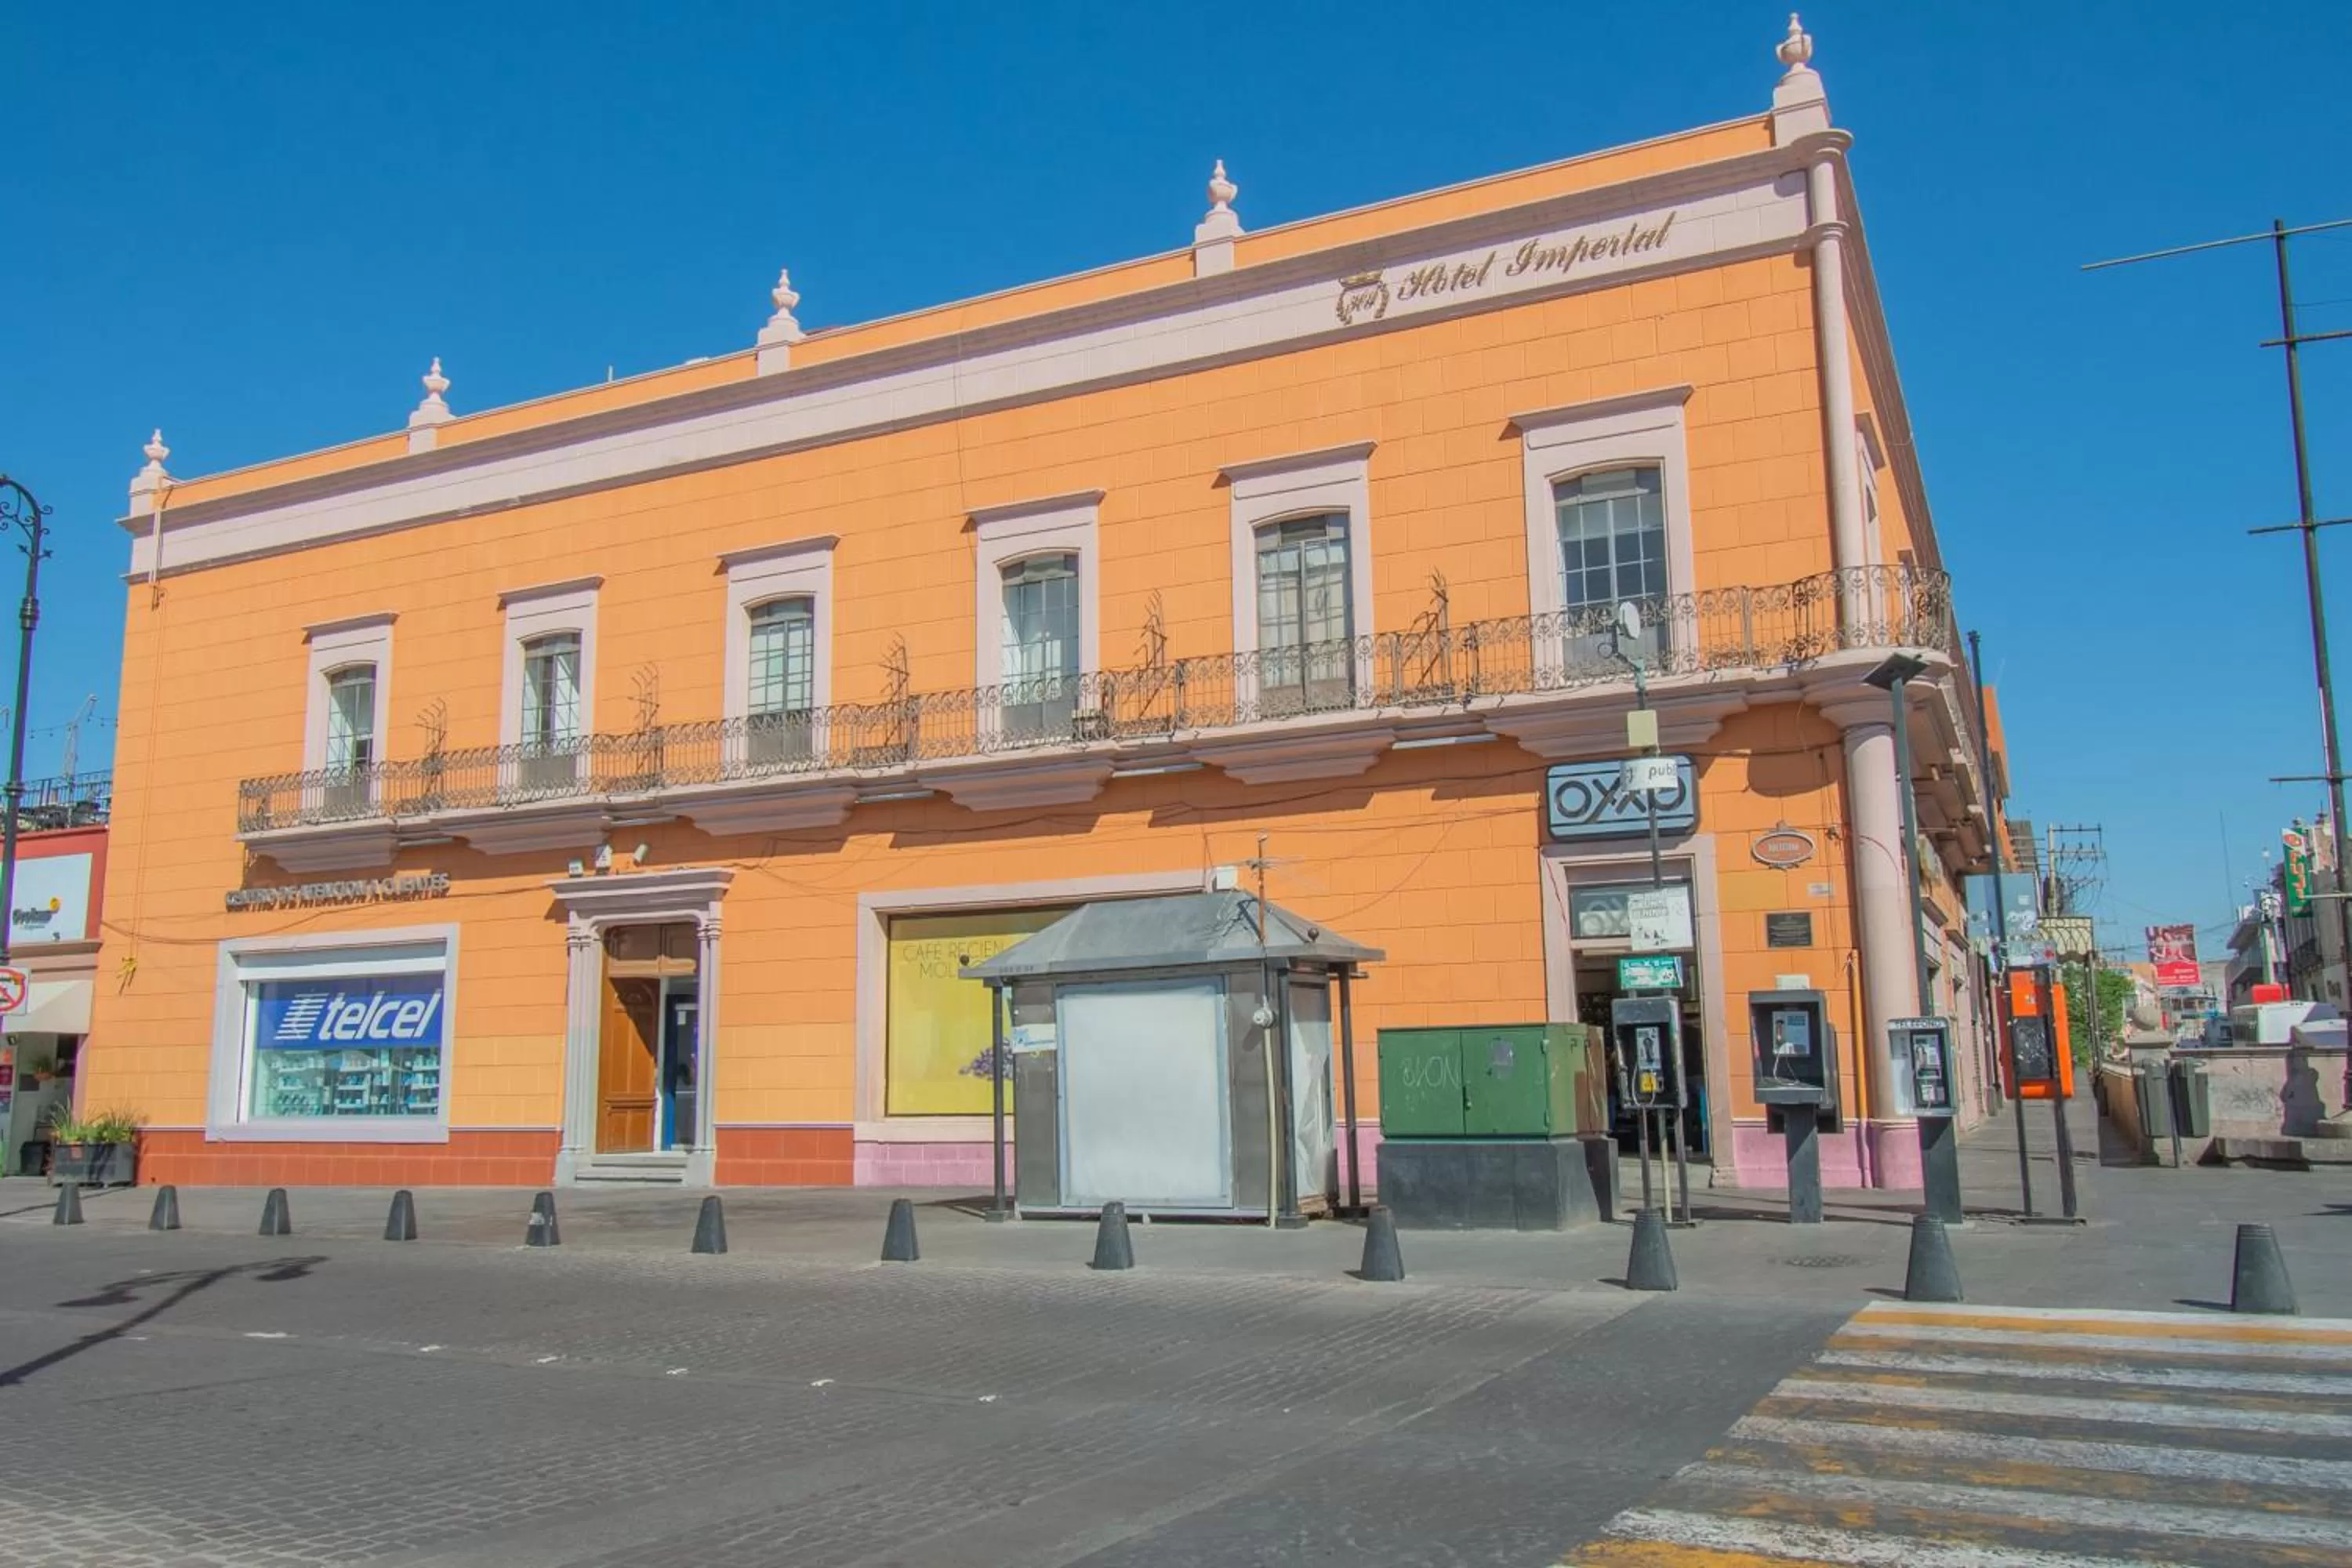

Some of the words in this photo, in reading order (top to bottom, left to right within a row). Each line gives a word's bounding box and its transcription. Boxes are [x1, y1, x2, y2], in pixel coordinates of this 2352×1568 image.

[1398, 251, 1497, 301] Hotel
[1504, 210, 1677, 276] Imperial
[318, 988, 443, 1040] telcel
